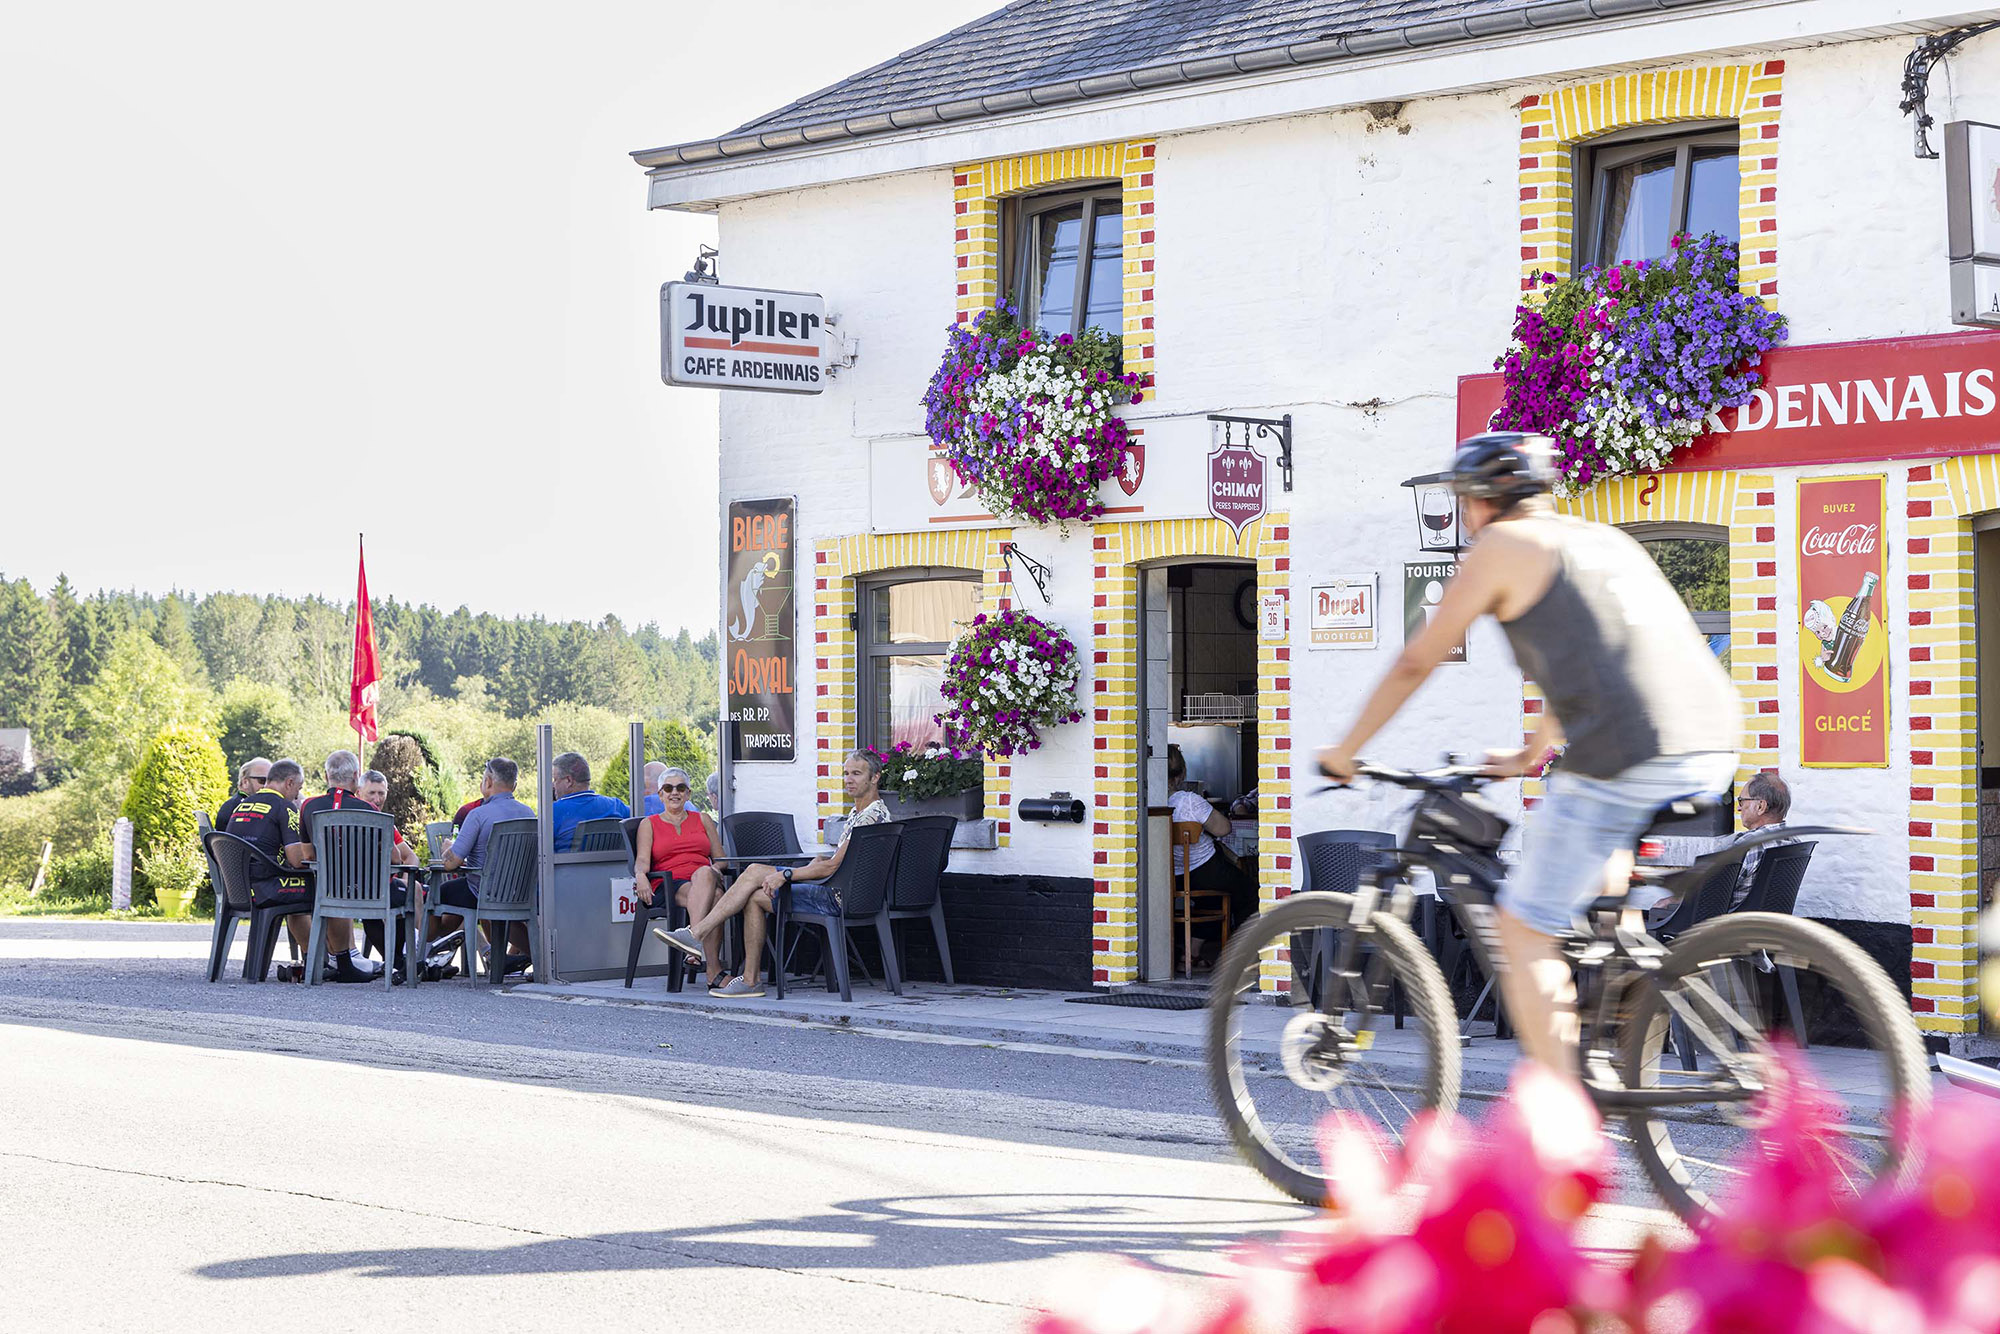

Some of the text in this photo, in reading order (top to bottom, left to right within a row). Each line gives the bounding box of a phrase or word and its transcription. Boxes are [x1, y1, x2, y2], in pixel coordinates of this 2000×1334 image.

[684, 293, 820, 345] Jupiler
[684, 356, 820, 382] CAFÉ ARDENNAIS
[1704, 368, 1997, 434] DENNAIS
[1212, 481, 1262, 498] CHIMAY
[1232, 502, 1260, 511] TRAPPISTES
[1823, 503, 1856, 514] BUVEZ
[733, 513, 788, 552] BIERE
[1801, 523, 1878, 556] Coca-Cola
[1264, 598, 1281, 607] Duvel
[1317, 591, 1366, 617] Duvel
[1267, 612, 1278, 626] 36
[1315, 632, 1369, 641] MOORTGAT
[730, 712, 741, 721] DES
[1815, 709, 1872, 732] GLACÉ
[744, 733, 792, 748] TRAPPISTES
